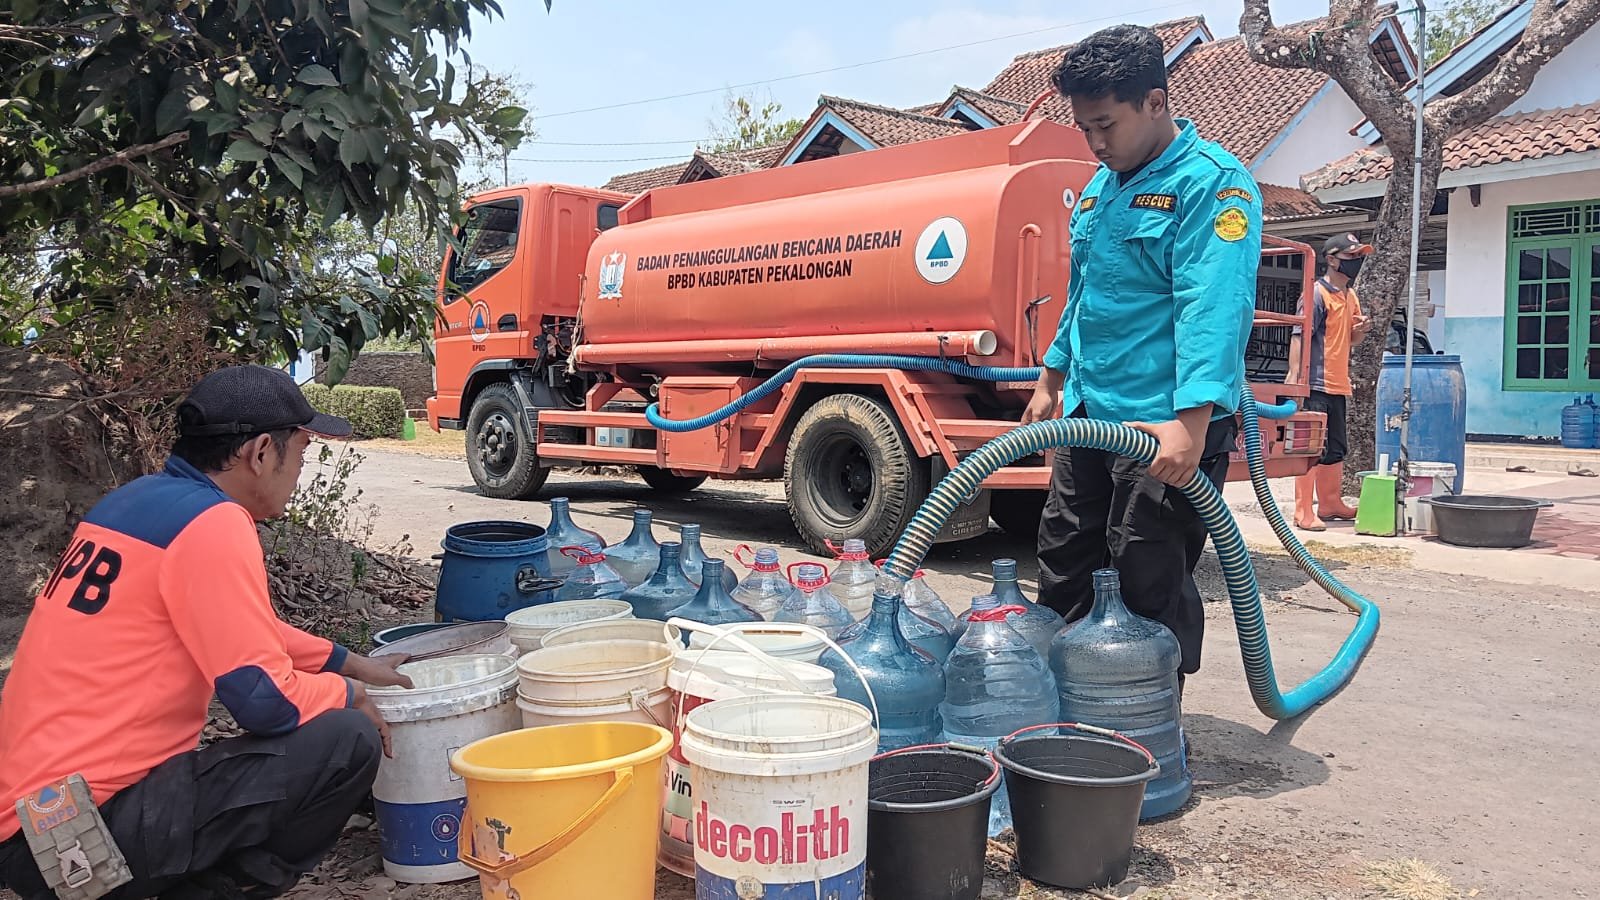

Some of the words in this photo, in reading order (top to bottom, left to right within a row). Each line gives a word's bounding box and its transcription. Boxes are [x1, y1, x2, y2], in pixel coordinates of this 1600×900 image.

[1135, 195, 1172, 208] RESCUE
[637, 255, 671, 271] BADAN
[672, 243, 779, 268] PENANGGULANGAN
[782, 236, 842, 259] BENCANA
[845, 229, 902, 252] DAERAH
[930, 260, 949, 268] BPBD
[667, 273, 696, 290] BPBD
[698, 266, 764, 288] KABUPATEN
[766, 259, 852, 282] PEKALONGAN
[696, 800, 849, 865] decolith
